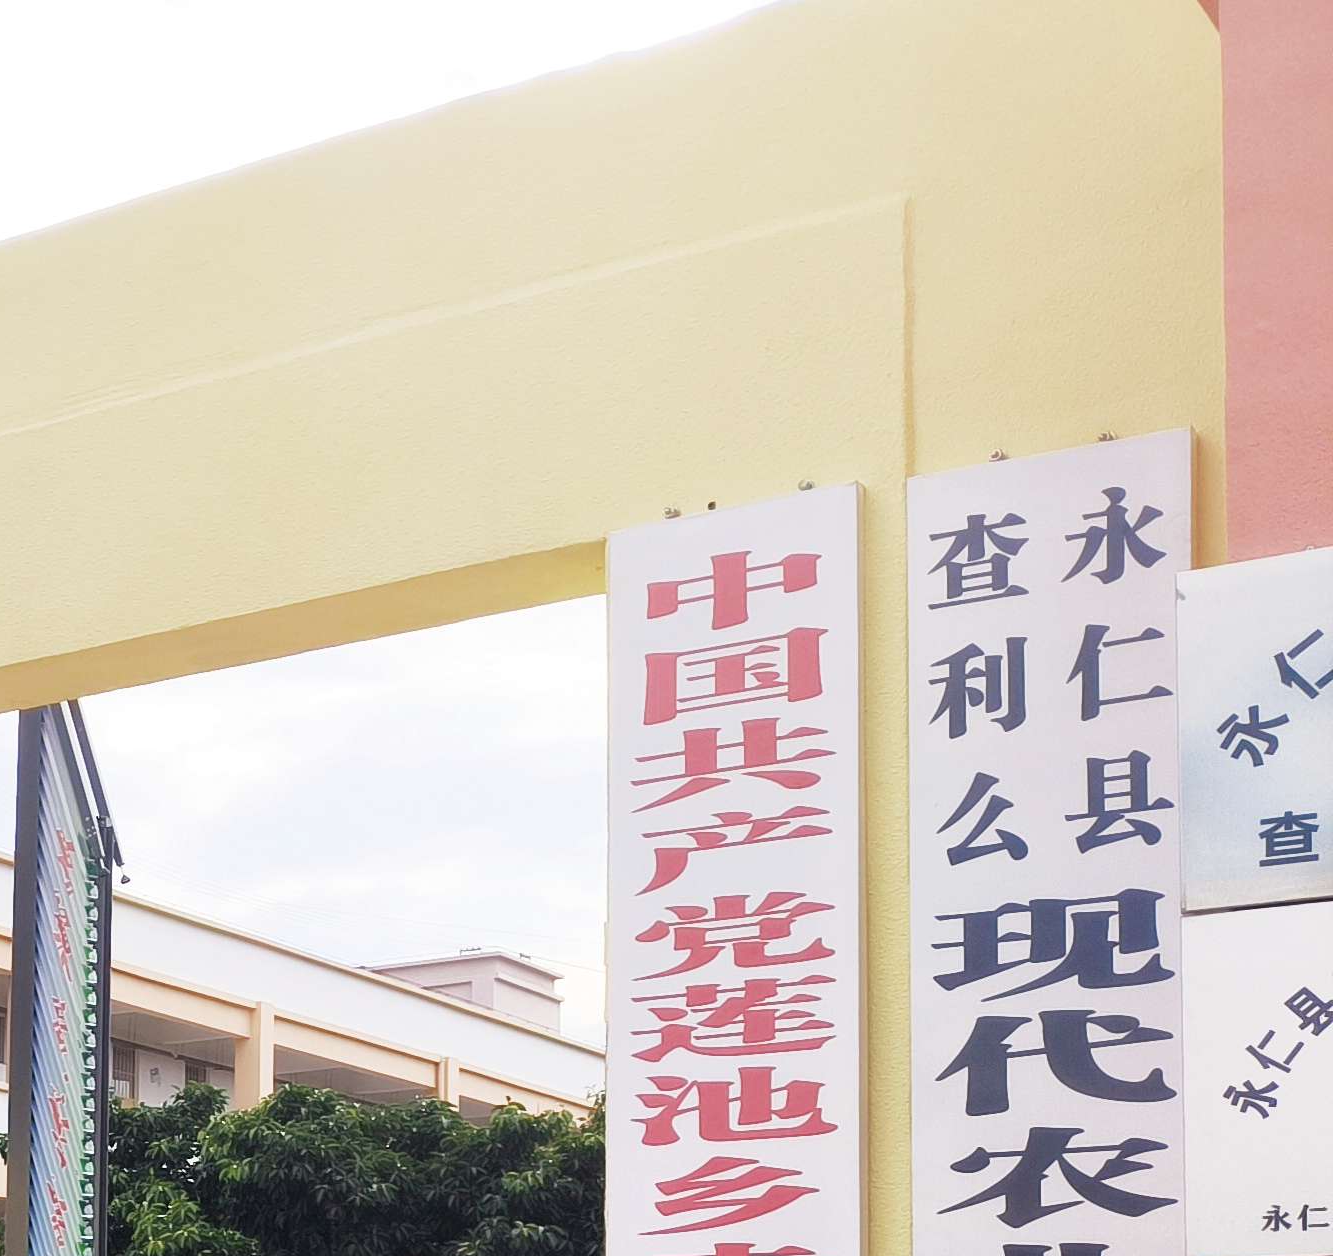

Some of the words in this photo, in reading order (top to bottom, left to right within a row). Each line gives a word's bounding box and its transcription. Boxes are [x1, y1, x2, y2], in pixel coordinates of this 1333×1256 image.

[927, 512, 1029, 866] 查利么
[1062, 486, 1175, 854] 永仁县
[1258, 810, 1319, 867] 查
